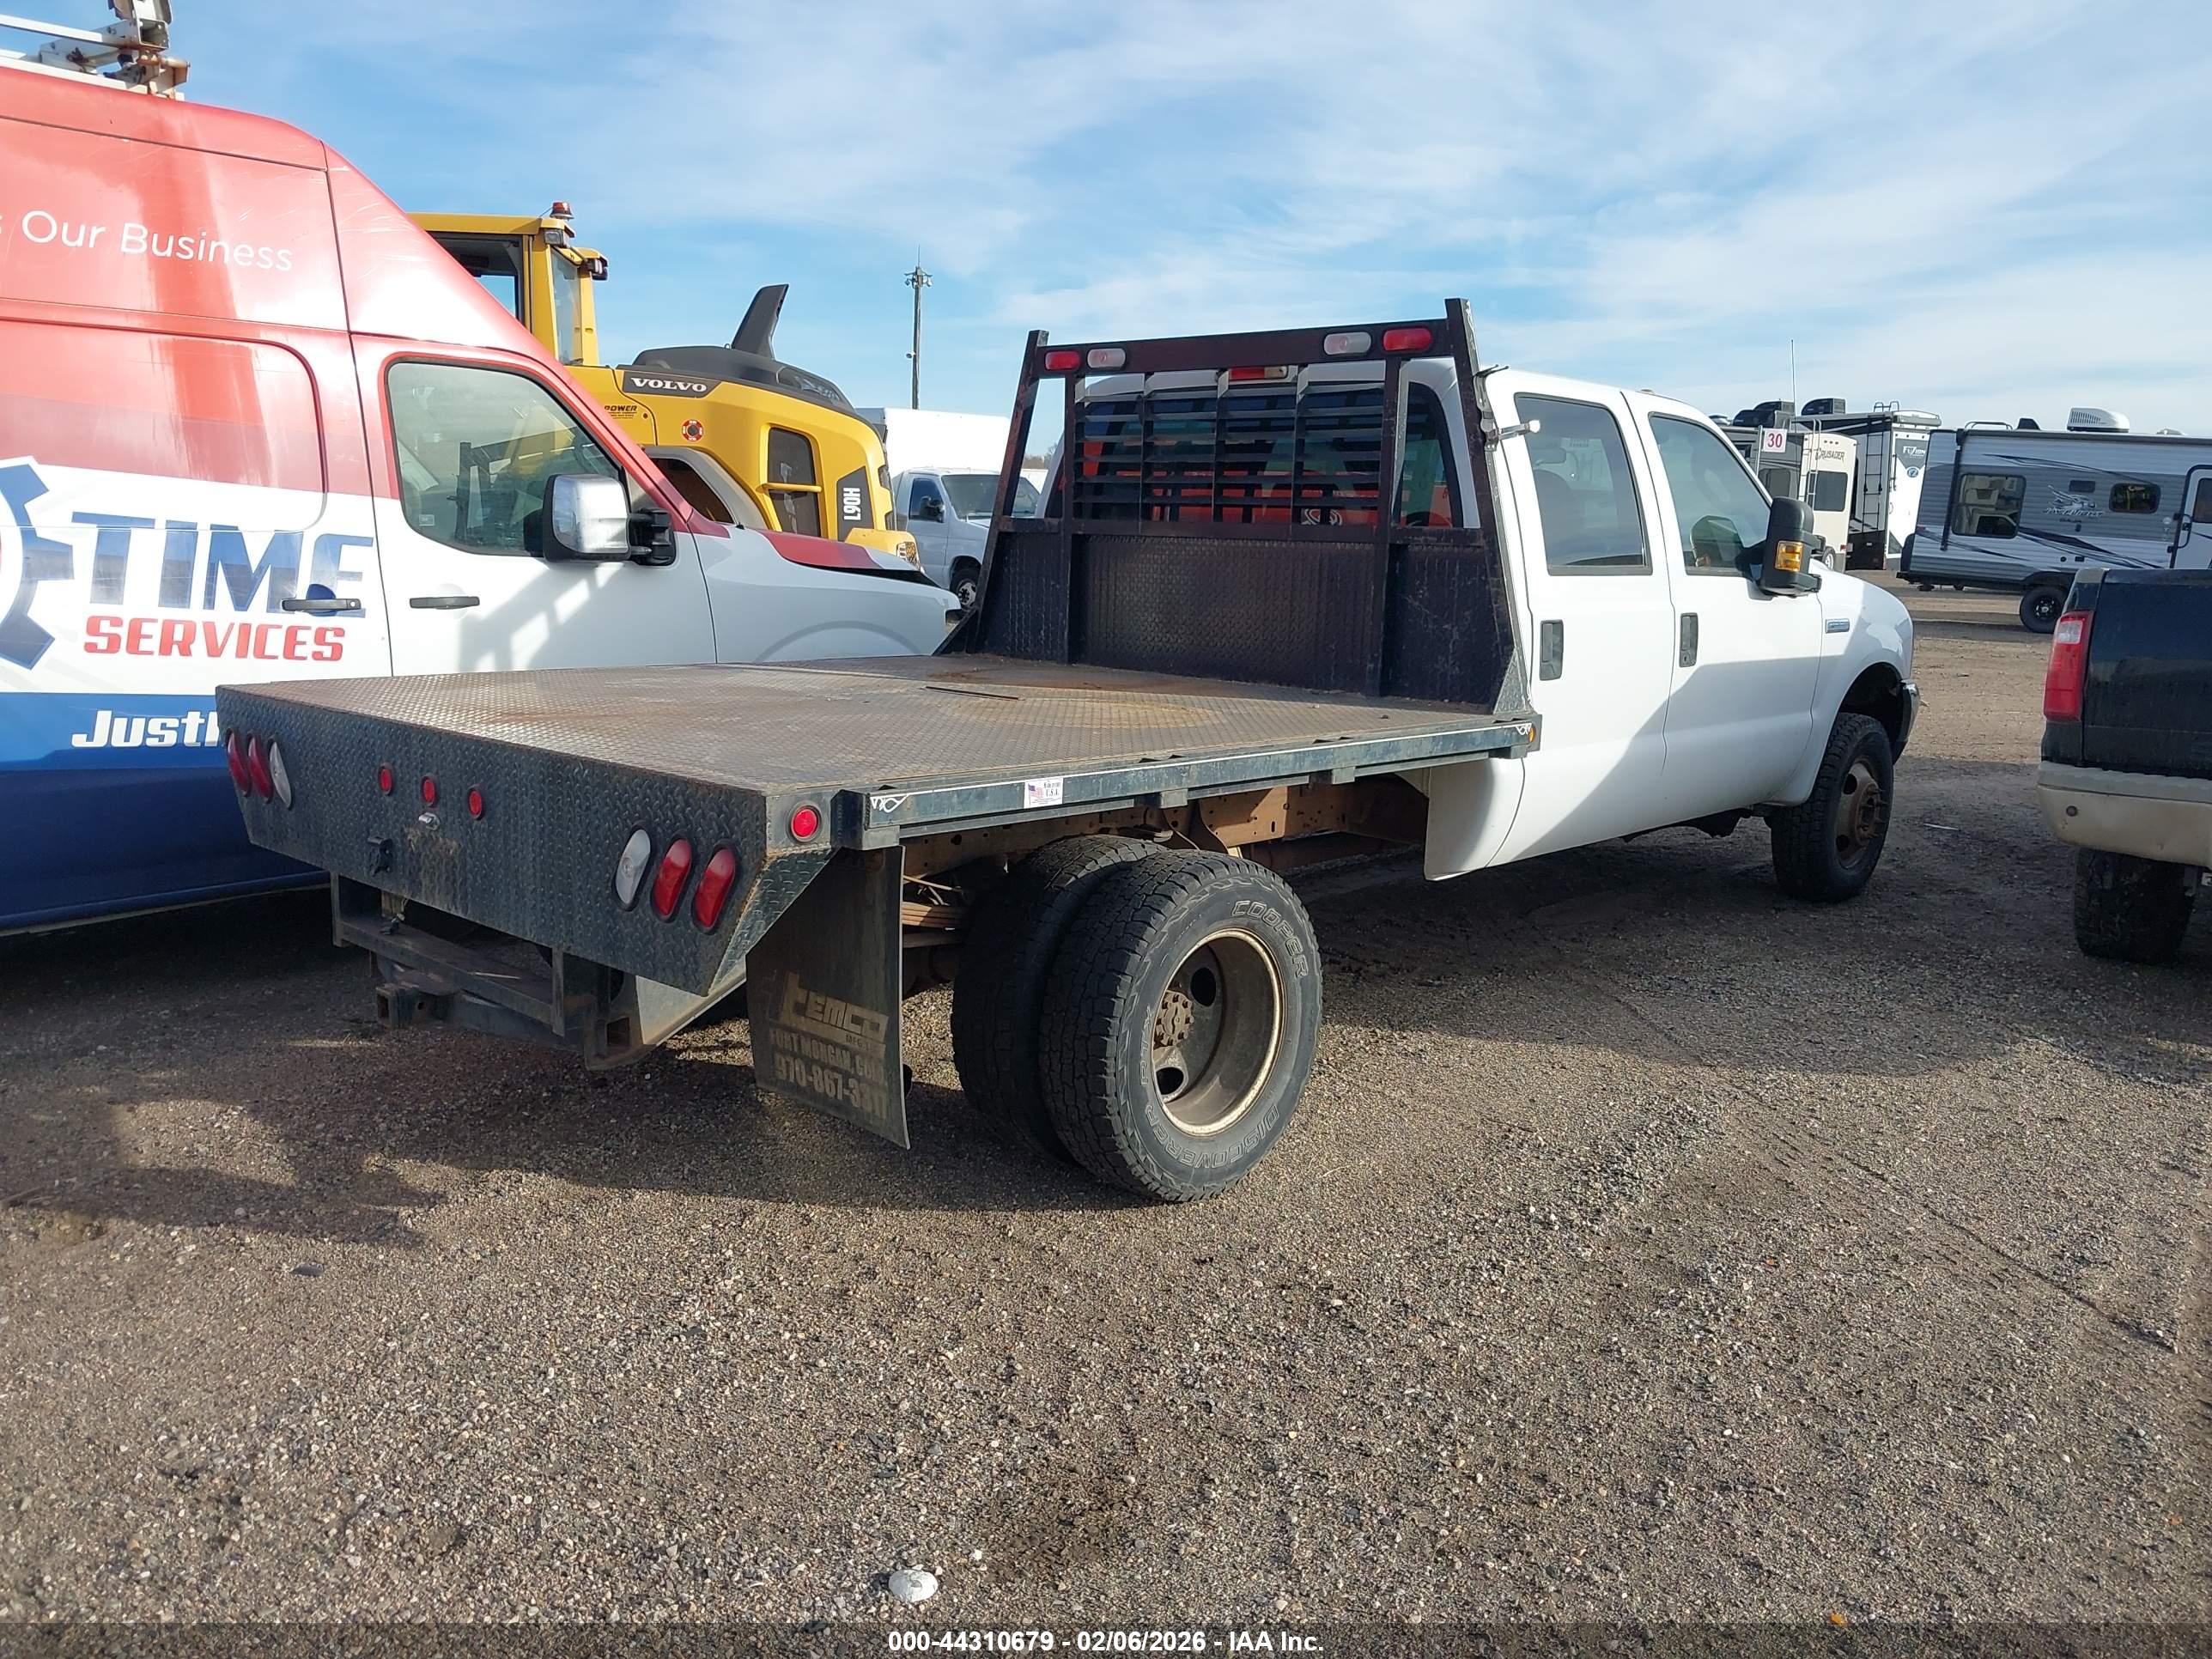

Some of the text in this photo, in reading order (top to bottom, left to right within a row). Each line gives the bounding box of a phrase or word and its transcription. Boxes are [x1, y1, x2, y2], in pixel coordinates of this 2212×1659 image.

[21, 210, 106, 248] Our
[119, 223, 293, 272] Business
[630, 377, 708, 392] VOLVO
[1767, 433, 1783, 448] 30
[842, 487, 861, 520] L90H
[71, 511, 374, 618] TIME
[83, 615, 346, 662] SERVICES
[1231, 900, 1309, 977] COOPER
[1145, 1104, 1279, 1169] DISCOVERER
